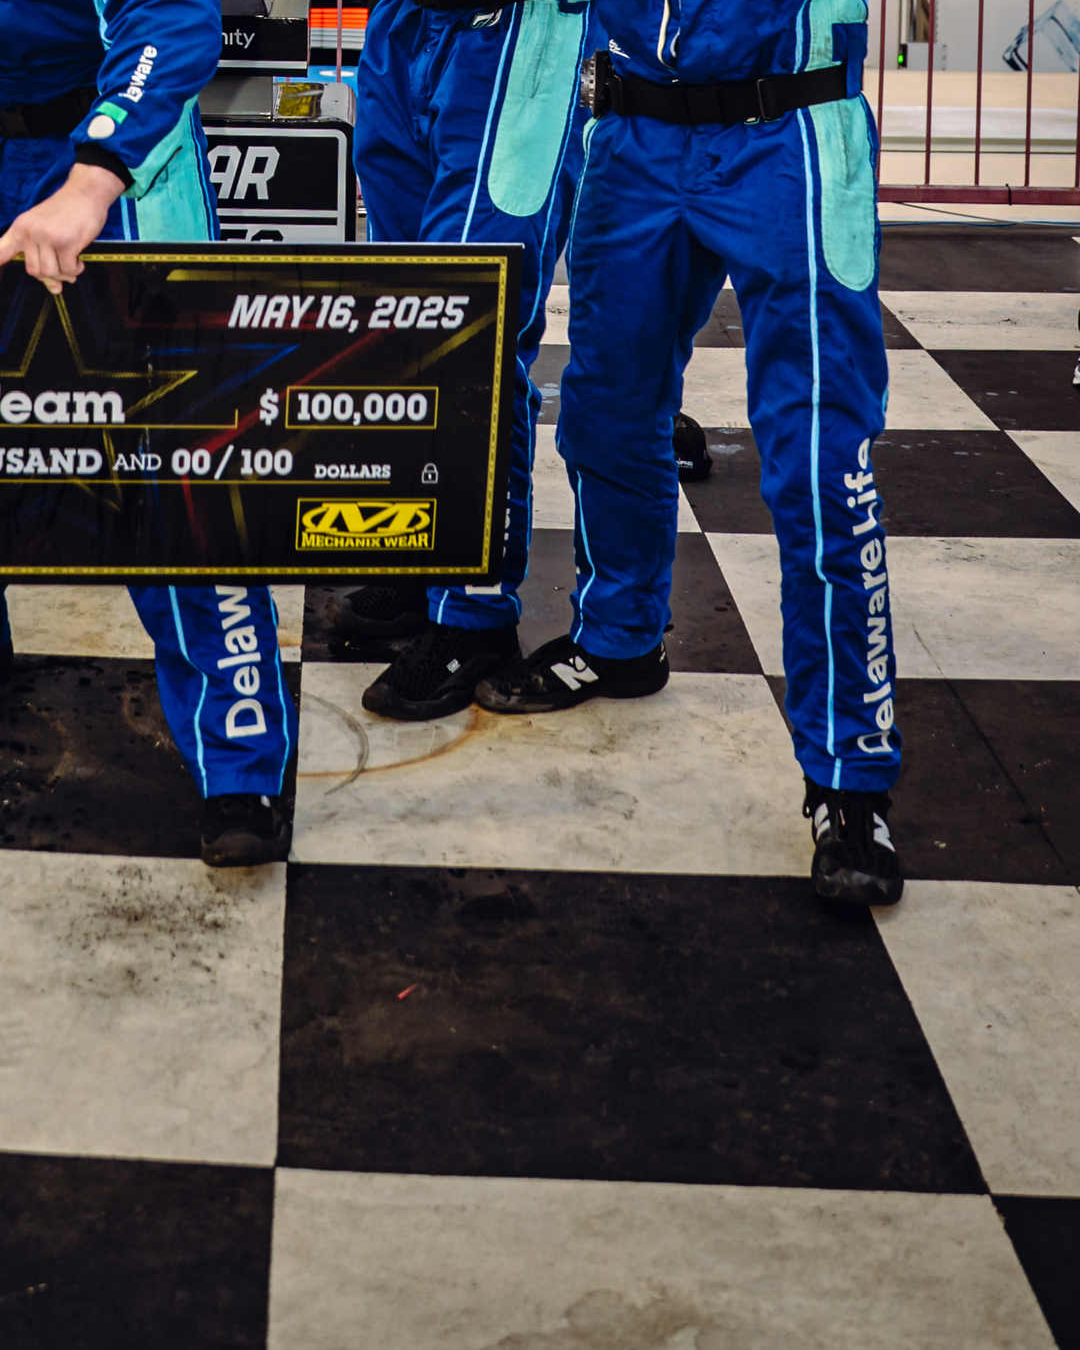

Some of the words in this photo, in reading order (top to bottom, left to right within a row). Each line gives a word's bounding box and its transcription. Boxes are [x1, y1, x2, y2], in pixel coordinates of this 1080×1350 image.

[227, 294, 315, 328] MAY
[316, 295, 359, 333] 16,
[368, 295, 470, 329] 2025
[259, 388, 279, 426] $
[297, 393, 428, 426] 100,000
[112, 454, 162, 471] AND
[314, 464, 391, 479] DOLLARS
[301, 532, 381, 548] MECHANIX
[384, 533, 430, 548] WEAR
[215, 585, 267, 738] Delaw
